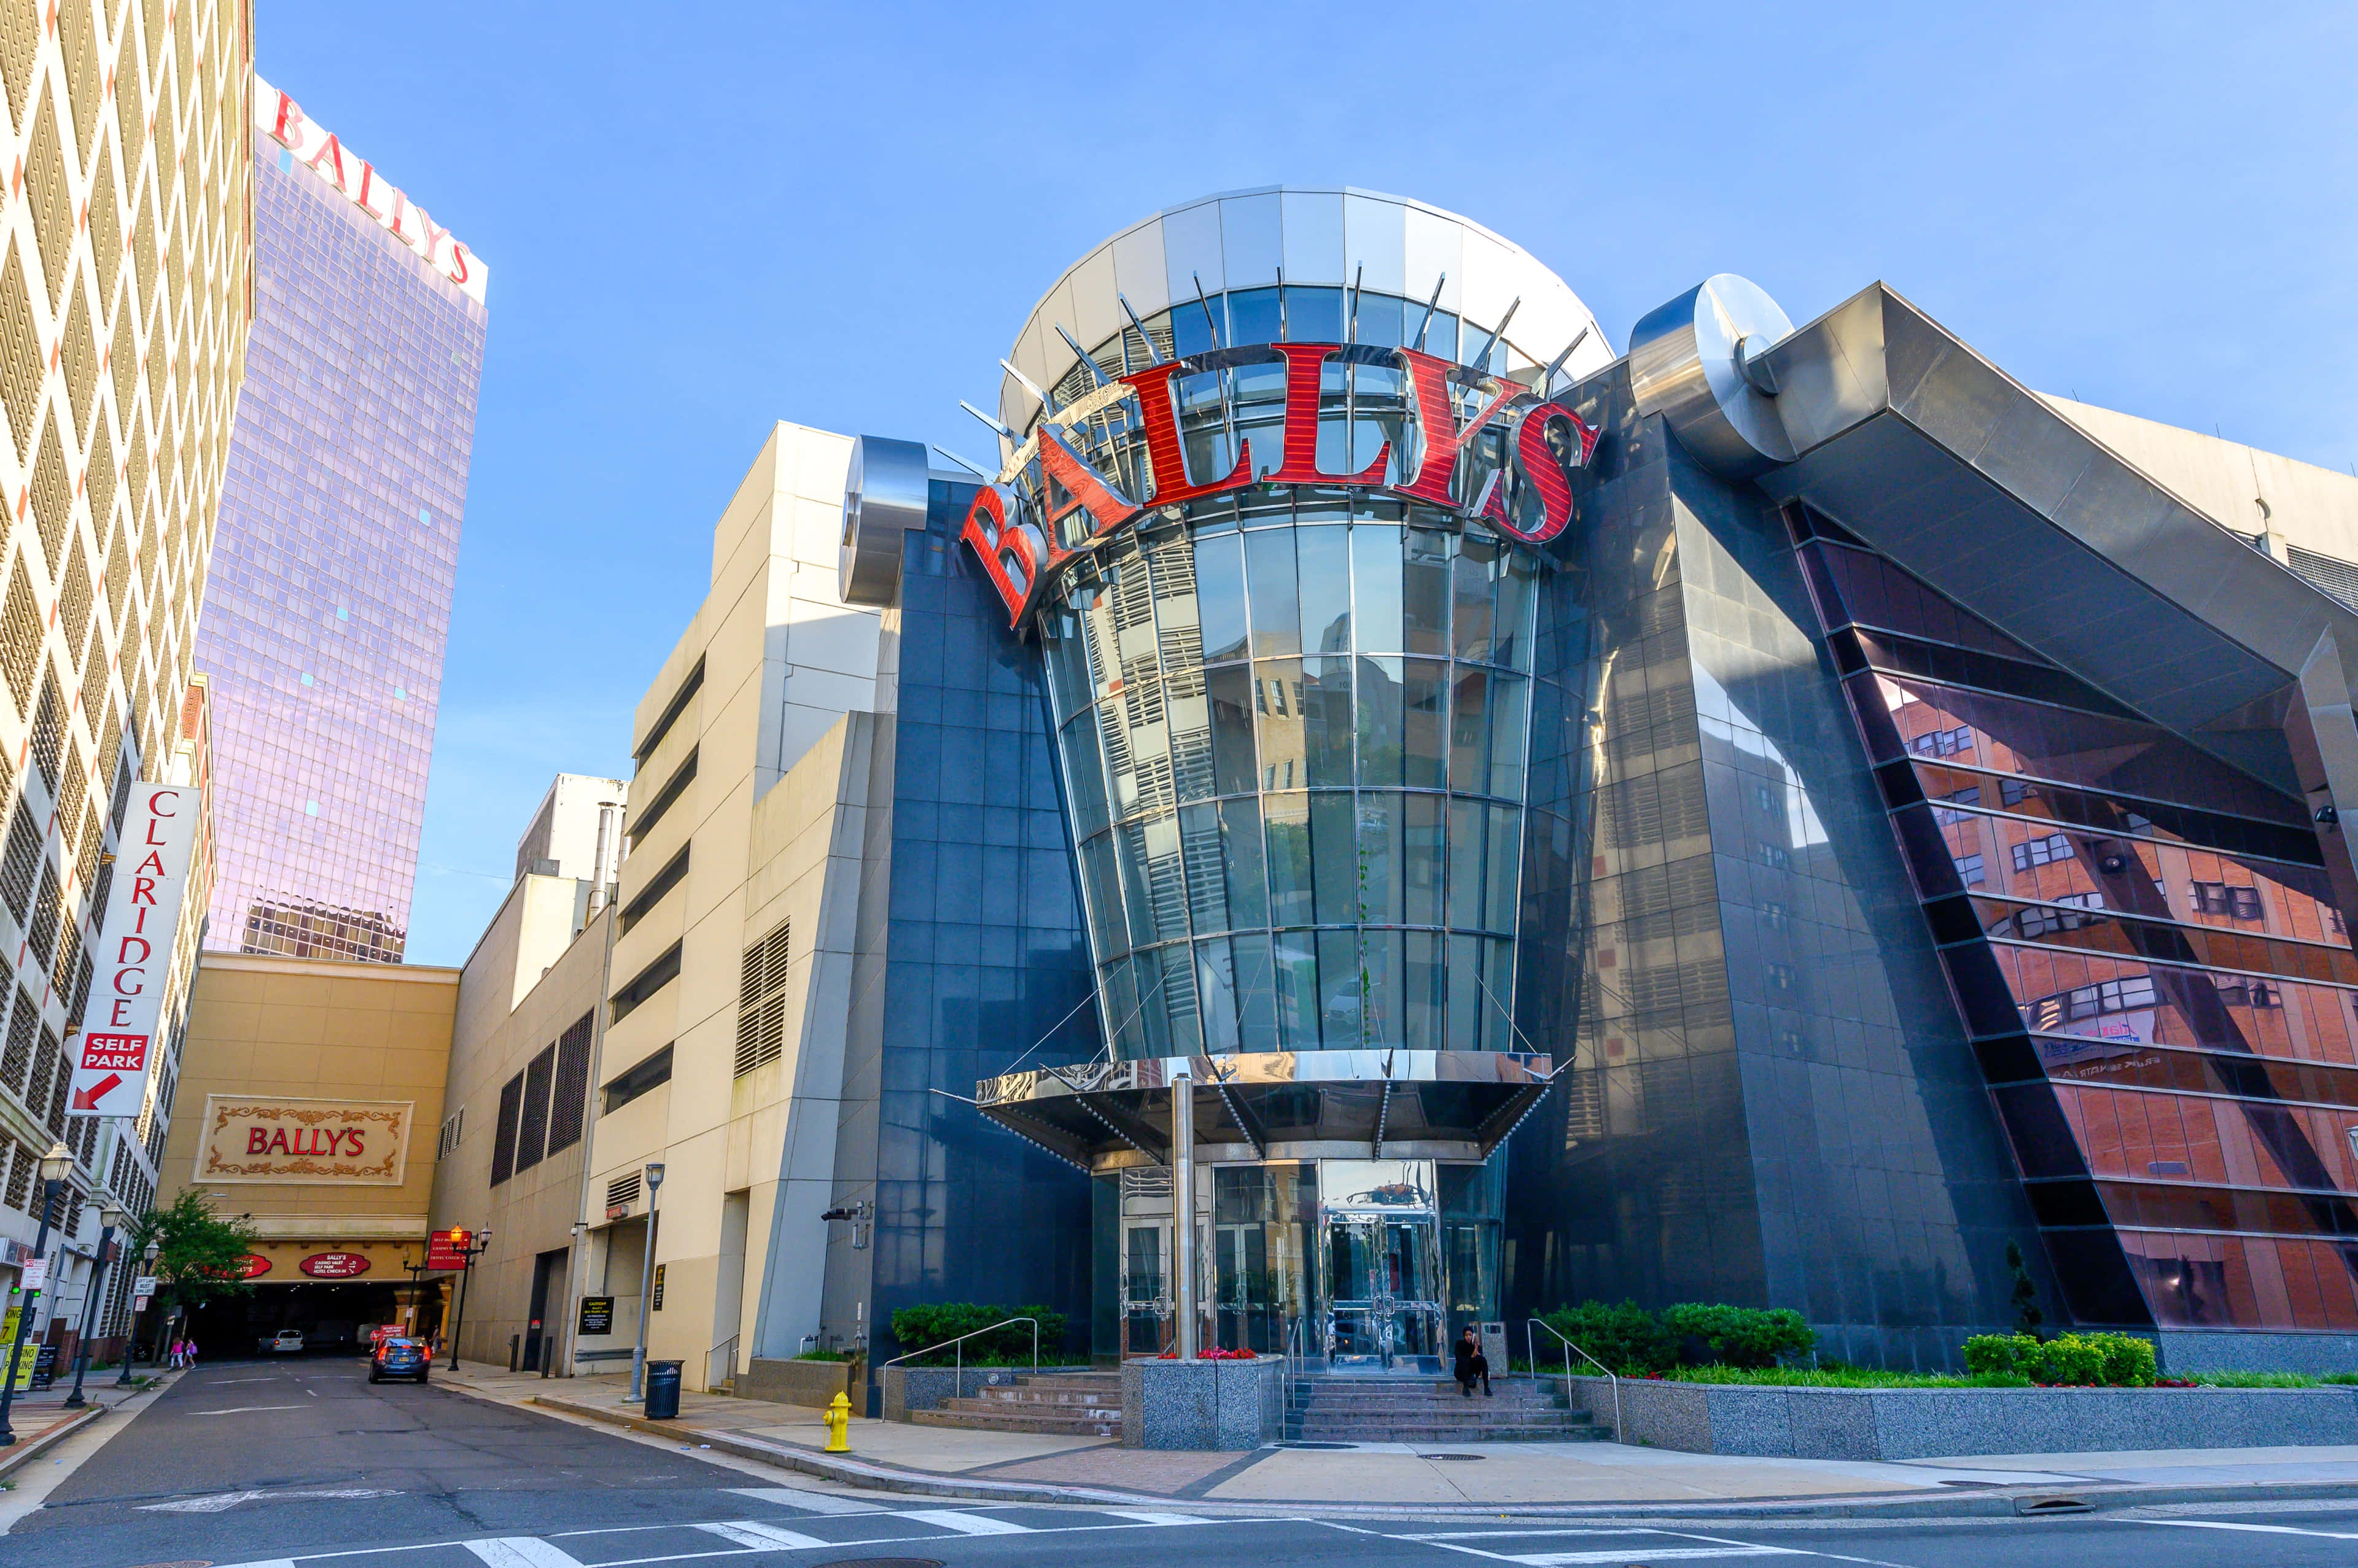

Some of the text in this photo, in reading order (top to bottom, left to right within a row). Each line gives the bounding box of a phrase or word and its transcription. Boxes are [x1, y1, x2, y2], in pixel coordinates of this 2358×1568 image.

[959, 342, 1602, 631] BALLYS
[109, 791, 179, 1028] CLARIDGE
[91, 1038, 142, 1052] SELF
[85, 1054, 141, 1068] PARK
[246, 1127, 365, 1156] BALLY'S
[4, 1360, 33, 1370] PKING
